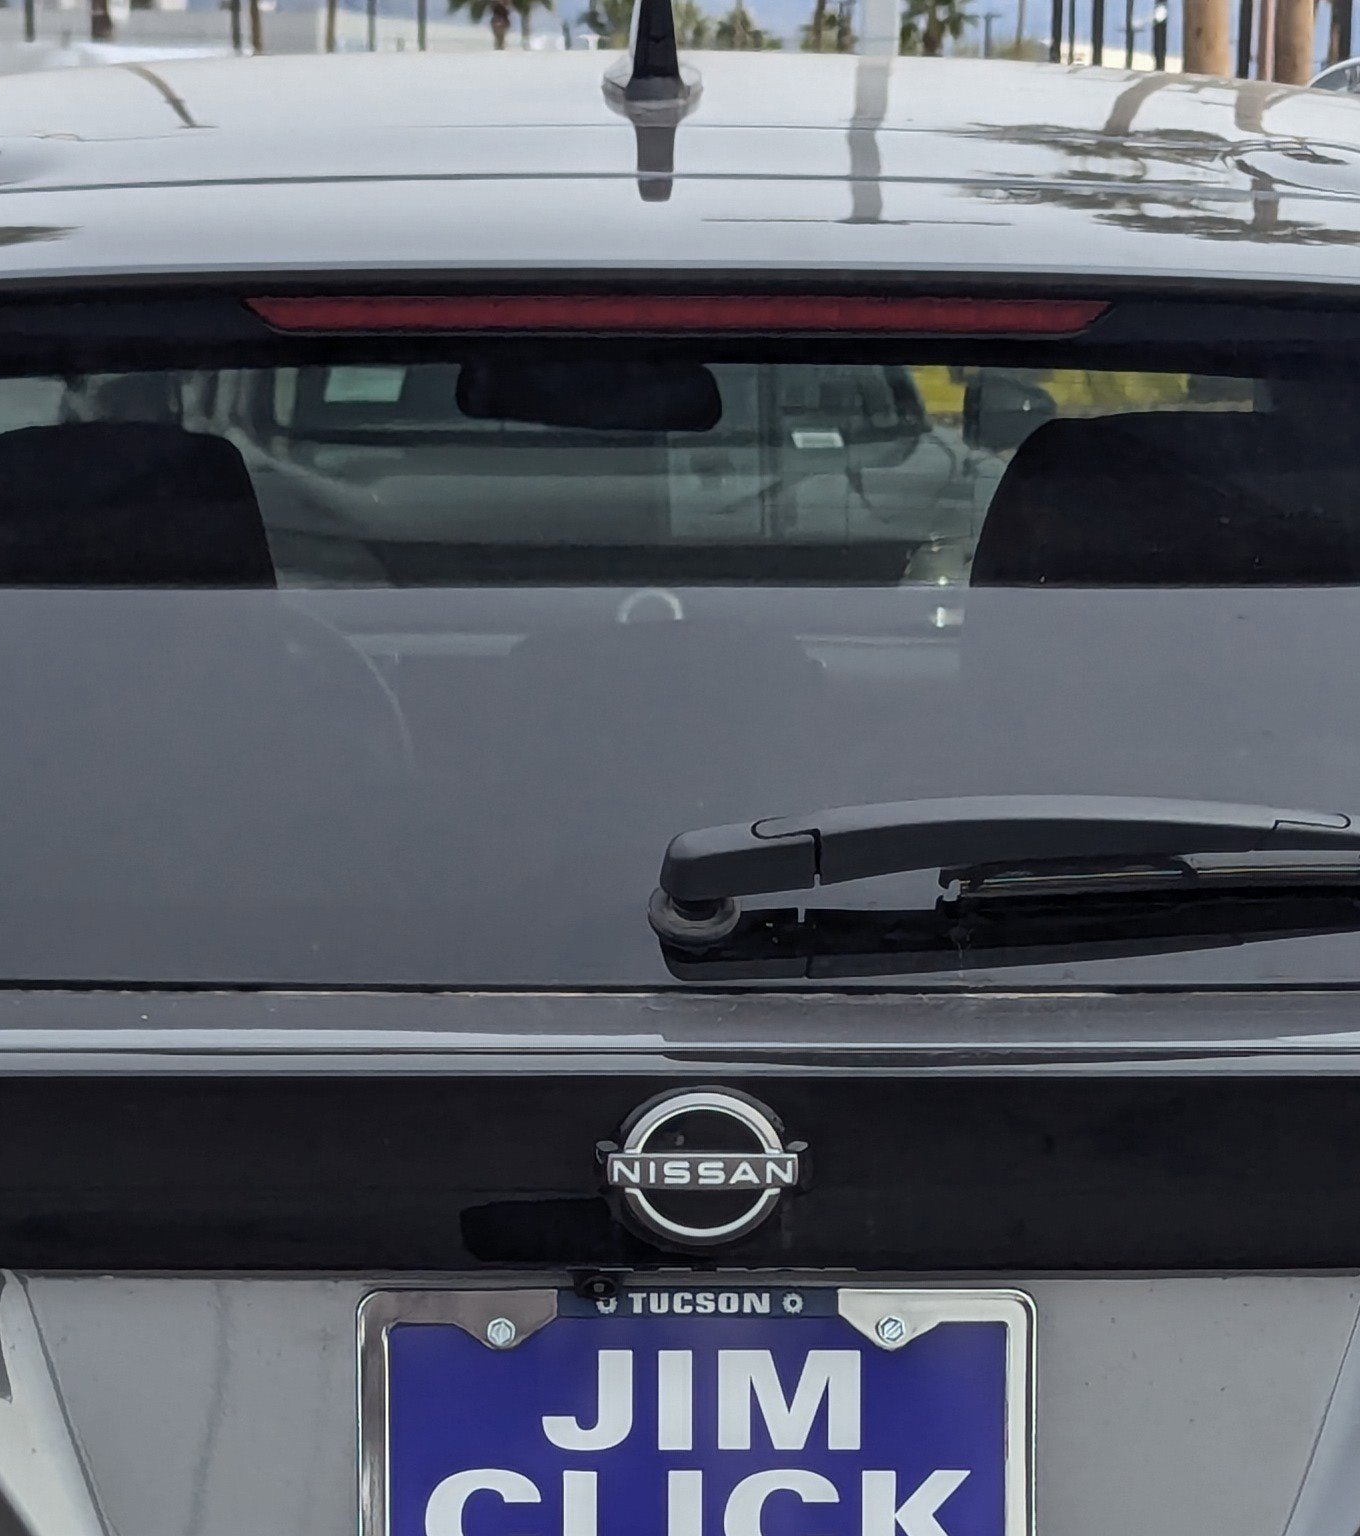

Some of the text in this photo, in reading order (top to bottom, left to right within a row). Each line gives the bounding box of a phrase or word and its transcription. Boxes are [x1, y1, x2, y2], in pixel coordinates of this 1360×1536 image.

[612, 1160, 792, 1185] NISSAN
[628, 1292, 771, 1315] TUCSON
[541, 1349, 861, 1451] JIM
